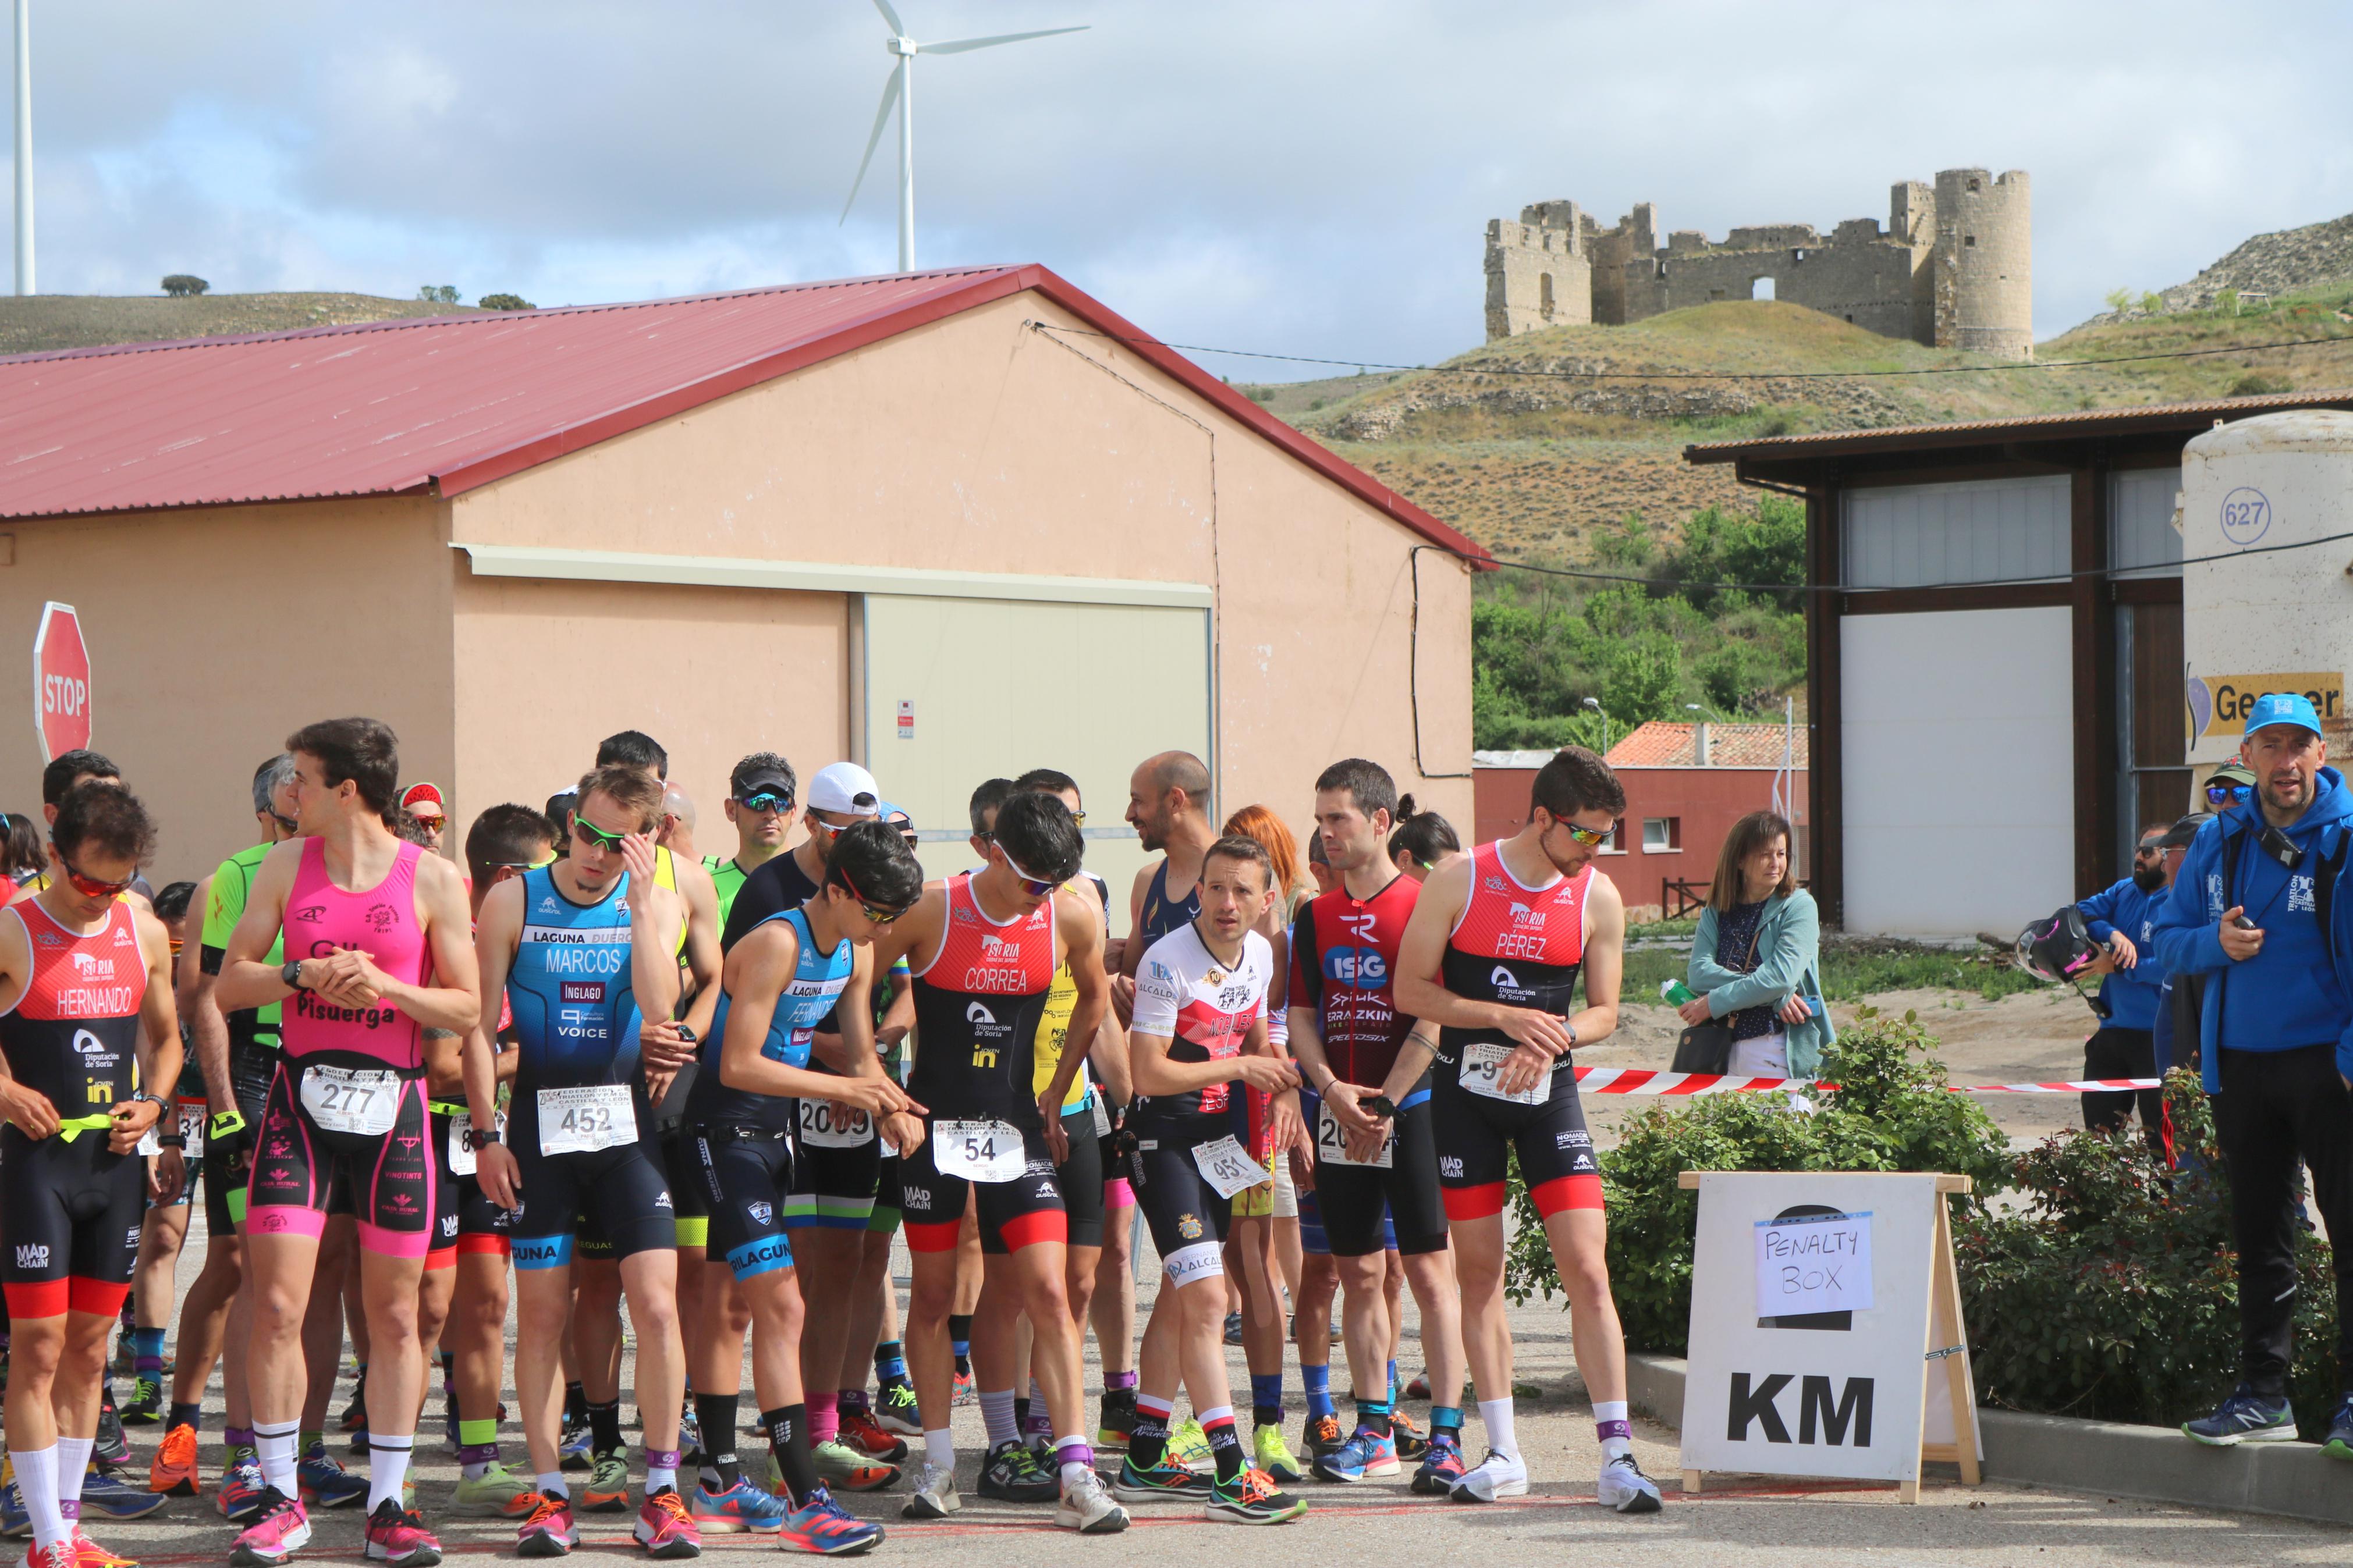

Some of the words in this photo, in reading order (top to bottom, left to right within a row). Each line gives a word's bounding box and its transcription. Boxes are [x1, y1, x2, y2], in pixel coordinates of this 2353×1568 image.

[2225, 502, 2265, 527] 627
[45, 674, 86, 717] STOP
[2216, 685, 2340, 721] Geer
[2287, 874, 2299, 912] TRIATLON
[534, 931, 585, 944] LAGUNA
[1495, 929, 1547, 960] PÉREZ
[546, 949, 621, 973] MARCOS
[1334, 955, 1386, 979] ISG
[792, 986, 822, 997] LAGUNA
[965, 967, 1027, 993] CORREA
[1499, 987, 1536, 996] Diputación
[57, 987, 132, 1016] HERNANDO
[297, 991, 395, 1029] Pisuerga
[975, 1023, 1012, 1032] Diputación
[1327, 1009, 1393, 1022] ERRAZKIN
[558, 1026, 608, 1039] VOICE
[85, 1053, 119, 1061] Diputación
[320, 1083, 376, 1114] 277
[560, 1107, 613, 1134] 452
[965, 1137, 996, 1161] 54
[1213, 1155, 1249, 1181] 951
[1439, 1154, 1464, 1170] MAD
[385, 1171, 423, 1180] VINOTINTO
[904, 1185, 931, 1201] MAD
[16, 1243, 49, 1260] MAD
[1765, 1231, 1858, 1260] PENALTY
[1781, 1264, 1843, 1295] BOX
[1727, 1372, 1875, 1448] KM
